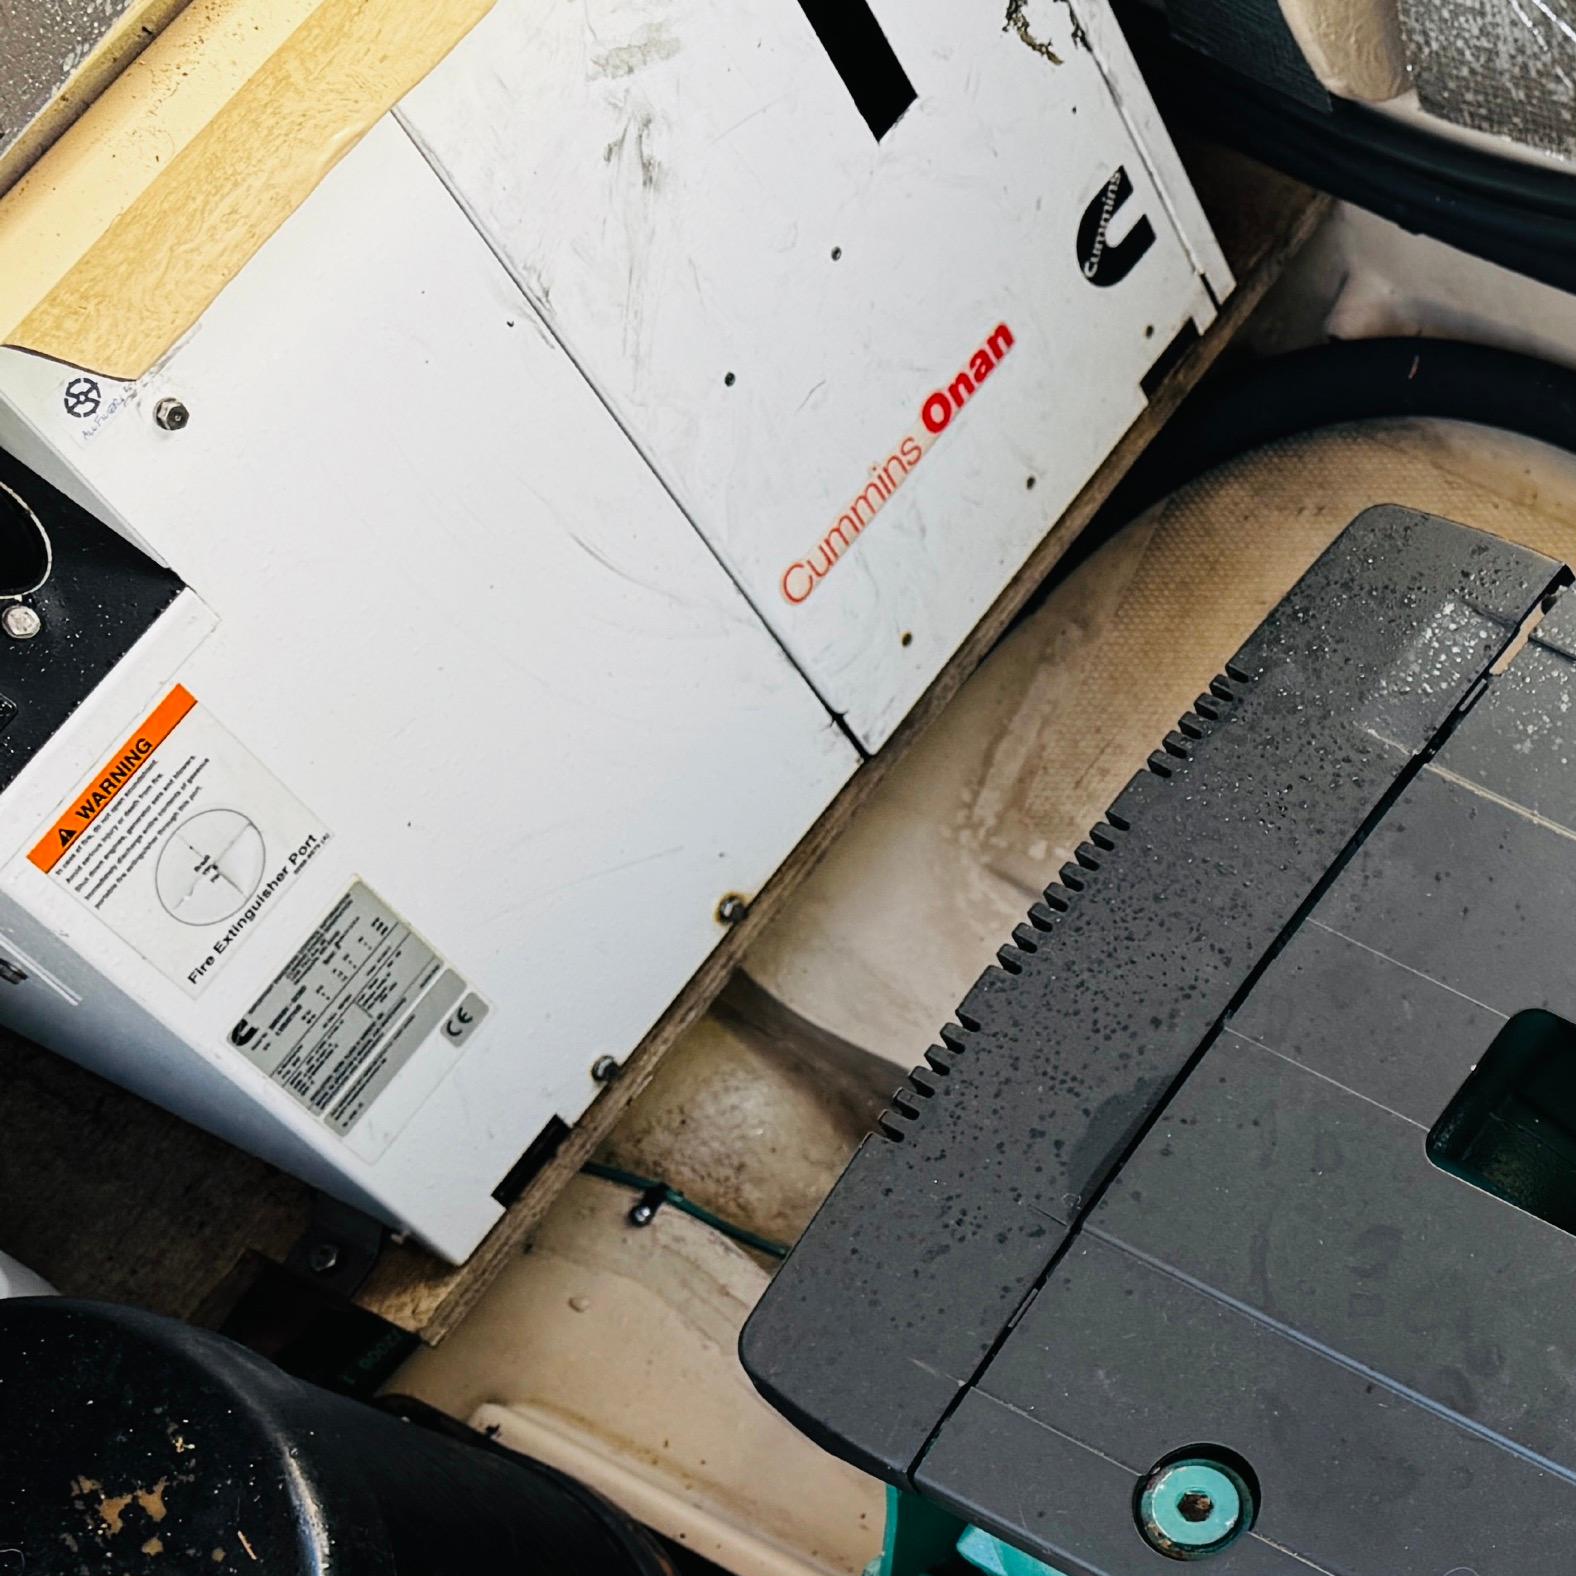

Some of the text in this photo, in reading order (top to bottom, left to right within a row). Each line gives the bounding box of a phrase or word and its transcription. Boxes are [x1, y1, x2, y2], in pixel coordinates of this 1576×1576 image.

[1081, 171, 1121, 278] Cummins
[780, 322, 1016, 604] Cummins Onan
[76, 738, 153, 820] WARNING
[188, 955, 216, 984] Fire
[216, 866, 289, 954] Extinguisher
[290, 834, 318, 866] Port
